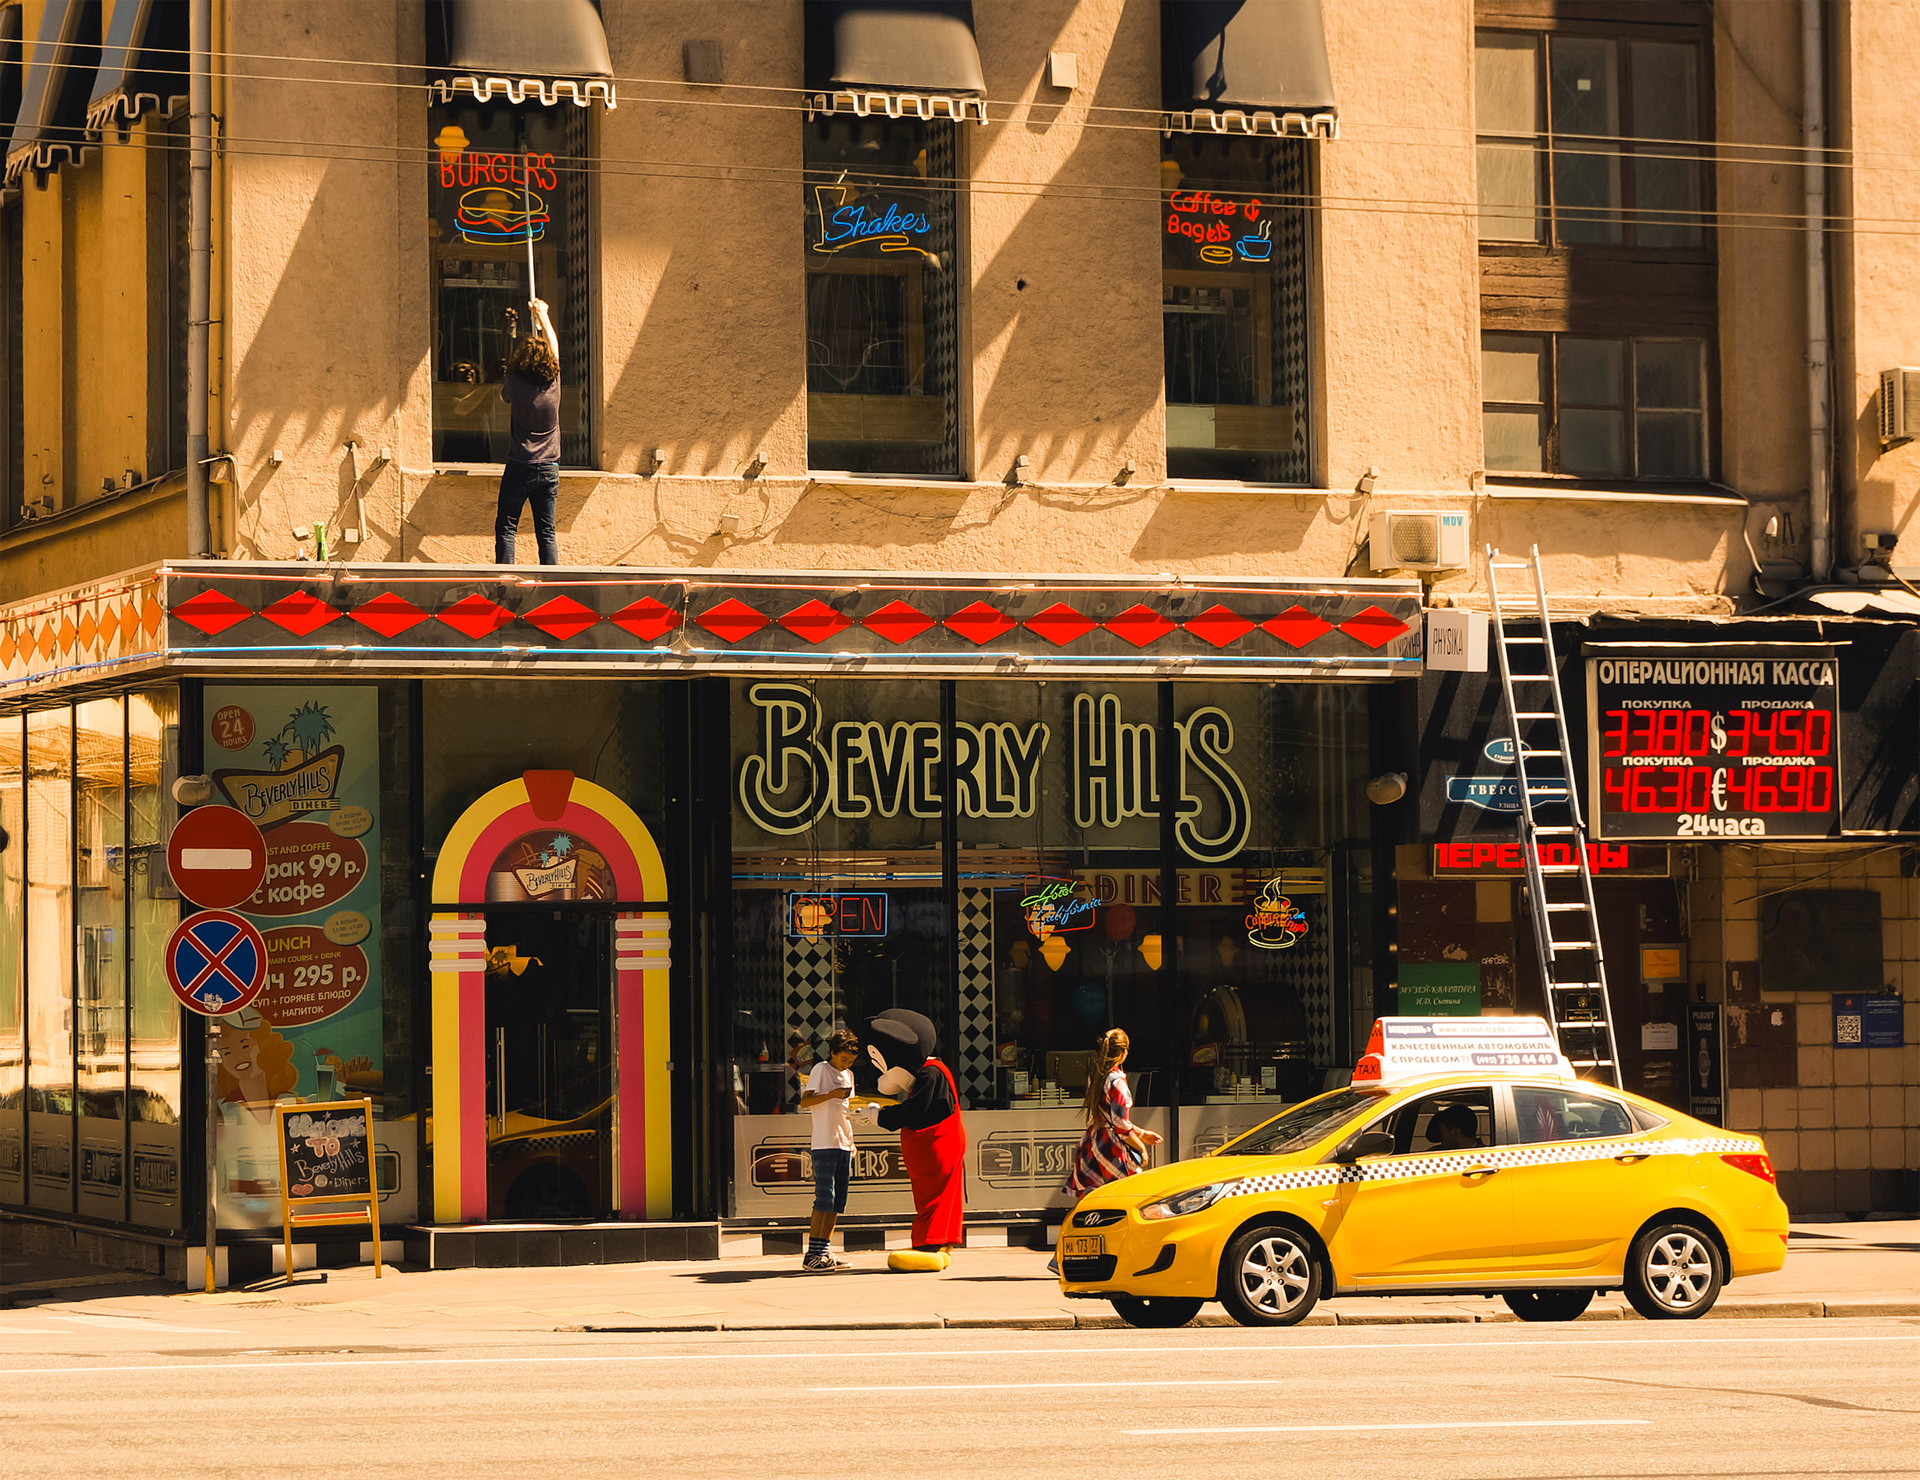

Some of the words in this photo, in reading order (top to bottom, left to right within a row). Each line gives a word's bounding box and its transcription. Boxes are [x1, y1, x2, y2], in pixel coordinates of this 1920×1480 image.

[440, 152, 558, 191] BURGERS
[1170, 191, 1237, 215] Coffee
[825, 203, 931, 241] Shakes
[1168, 214, 1231, 243] Bagels
[1442, 516, 1463, 526] MDV
[1432, 628, 1464, 656] PHYSIKA
[1600, 661, 1764, 685] ОПЕРАЦИОННАЯ
[1772, 662, 1834, 686] КАССА
[217, 709, 241, 720] OPEN
[1622, 700, 1692, 709] ПОКУПКА
[1741, 700, 1815, 709] ПРОДАЖА
[219, 718, 244, 738] 24
[1622, 757, 1693, 766] ПОКУПКА
[1742, 757, 1816, 766] ПРОДАЖА
[739, 683, 1050, 836] BEVERLY
[1073, 692, 1253, 863] HILLS
[293, 801, 327, 810] DINER
[280, 846, 299, 855] AND
[301, 842, 331, 852] COFFEE
[309, 853, 341, 878] 99
[345, 861, 360, 878] р.
[268, 880, 325, 905] кофе
[1020, 881, 1077, 907] Hotel
[1095, 874, 1222, 904] DINER
[795, 897, 882, 931] OPEN
[1034, 898, 1101, 929] California
[267, 936, 311, 952] UNCH
[287, 954, 313, 963] COURSE
[321, 951, 341, 960] DRINK
[294, 964, 333, 988] 295
[342, 966, 361, 988] р.
[252, 998, 269, 1008] СУП
[280, 993, 315, 1004] ГОРЯЧЕЕ
[318, 990, 351, 1000] БЛЮДО
[282, 1006, 324, 1017] НАПИТОК
[1391, 1042, 1475, 1050] КАЧЕСТВЕННЫЙ
[1478, 1042, 1551, 1050] АВТОМОБИЛЬ
[1358, 1064, 1379, 1075] TAXI
[305, 1137, 340, 1157] TO
[1020, 1145, 1077, 1171] DESSE
[294, 1154, 338, 1182] Beverly
[339, 1148, 365, 1171] Hills
[801, 1150, 889, 1177] BERS
[1076, 1239, 1088, 1253] 173
